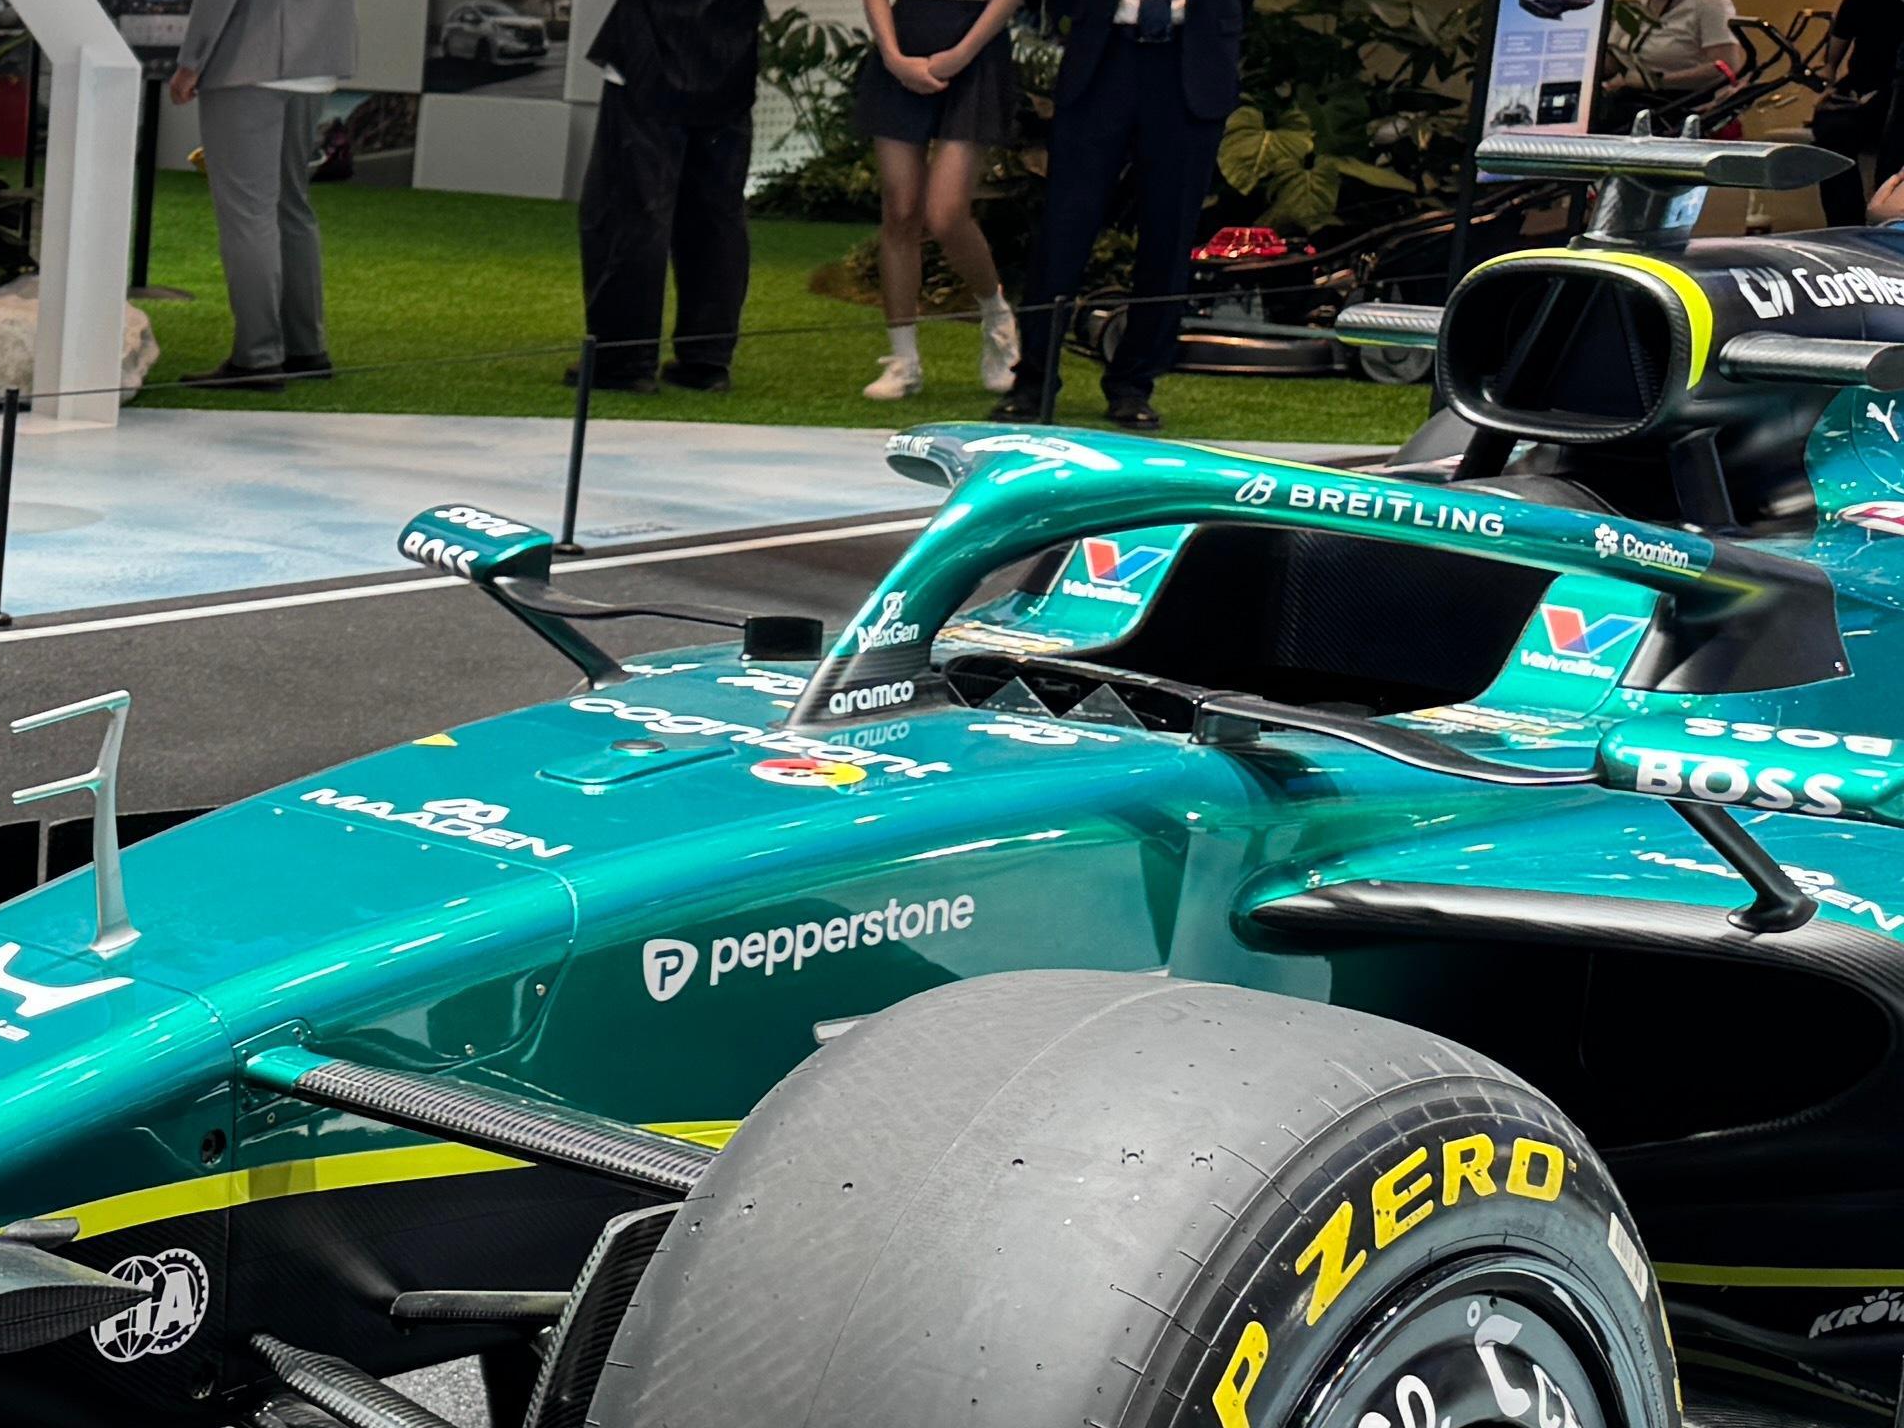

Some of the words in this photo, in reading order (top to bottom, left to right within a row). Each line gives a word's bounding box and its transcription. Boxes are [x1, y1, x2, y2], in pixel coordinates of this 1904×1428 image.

[1287, 483, 1505, 539] BREITLING
[403, 530, 480, 579] BOSS
[1620, 531, 1689, 571] Cognition
[1520, 649, 1615, 680] Valvoline
[827, 677, 915, 716] aramco
[568, 695, 953, 785] cognizant
[1635, 749, 1845, 817] BOSS
[301, 787, 575, 861] MAADEN
[709, 891, 977, 987] pepperstone
[1294, 1132, 1566, 1328] ZERO
